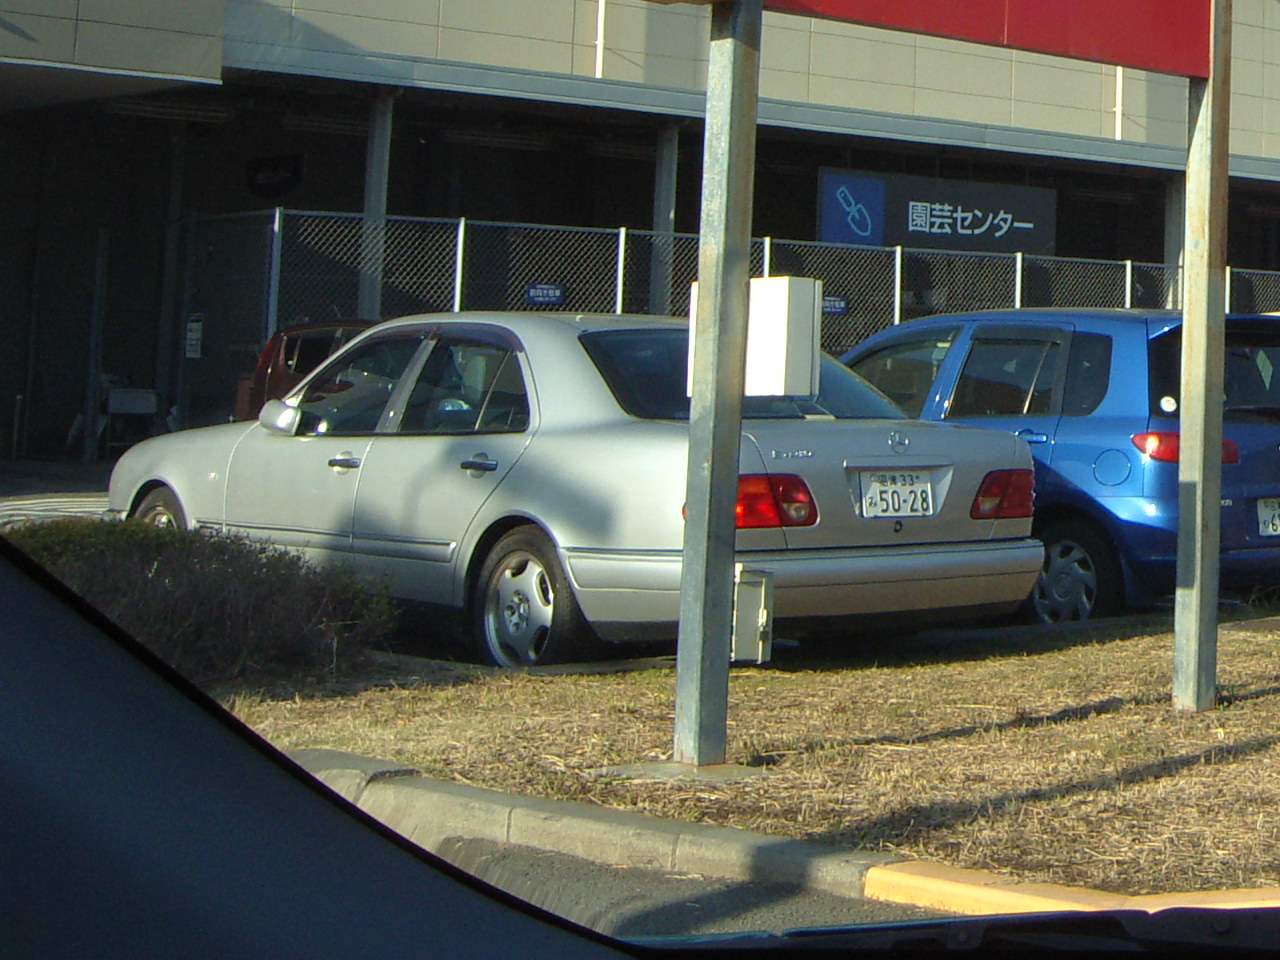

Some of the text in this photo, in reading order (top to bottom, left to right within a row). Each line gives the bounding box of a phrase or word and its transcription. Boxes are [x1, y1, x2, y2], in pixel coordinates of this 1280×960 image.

[908, 200, 1034, 238] 園芸センター
[878, 489, 930, 513] 50-28
